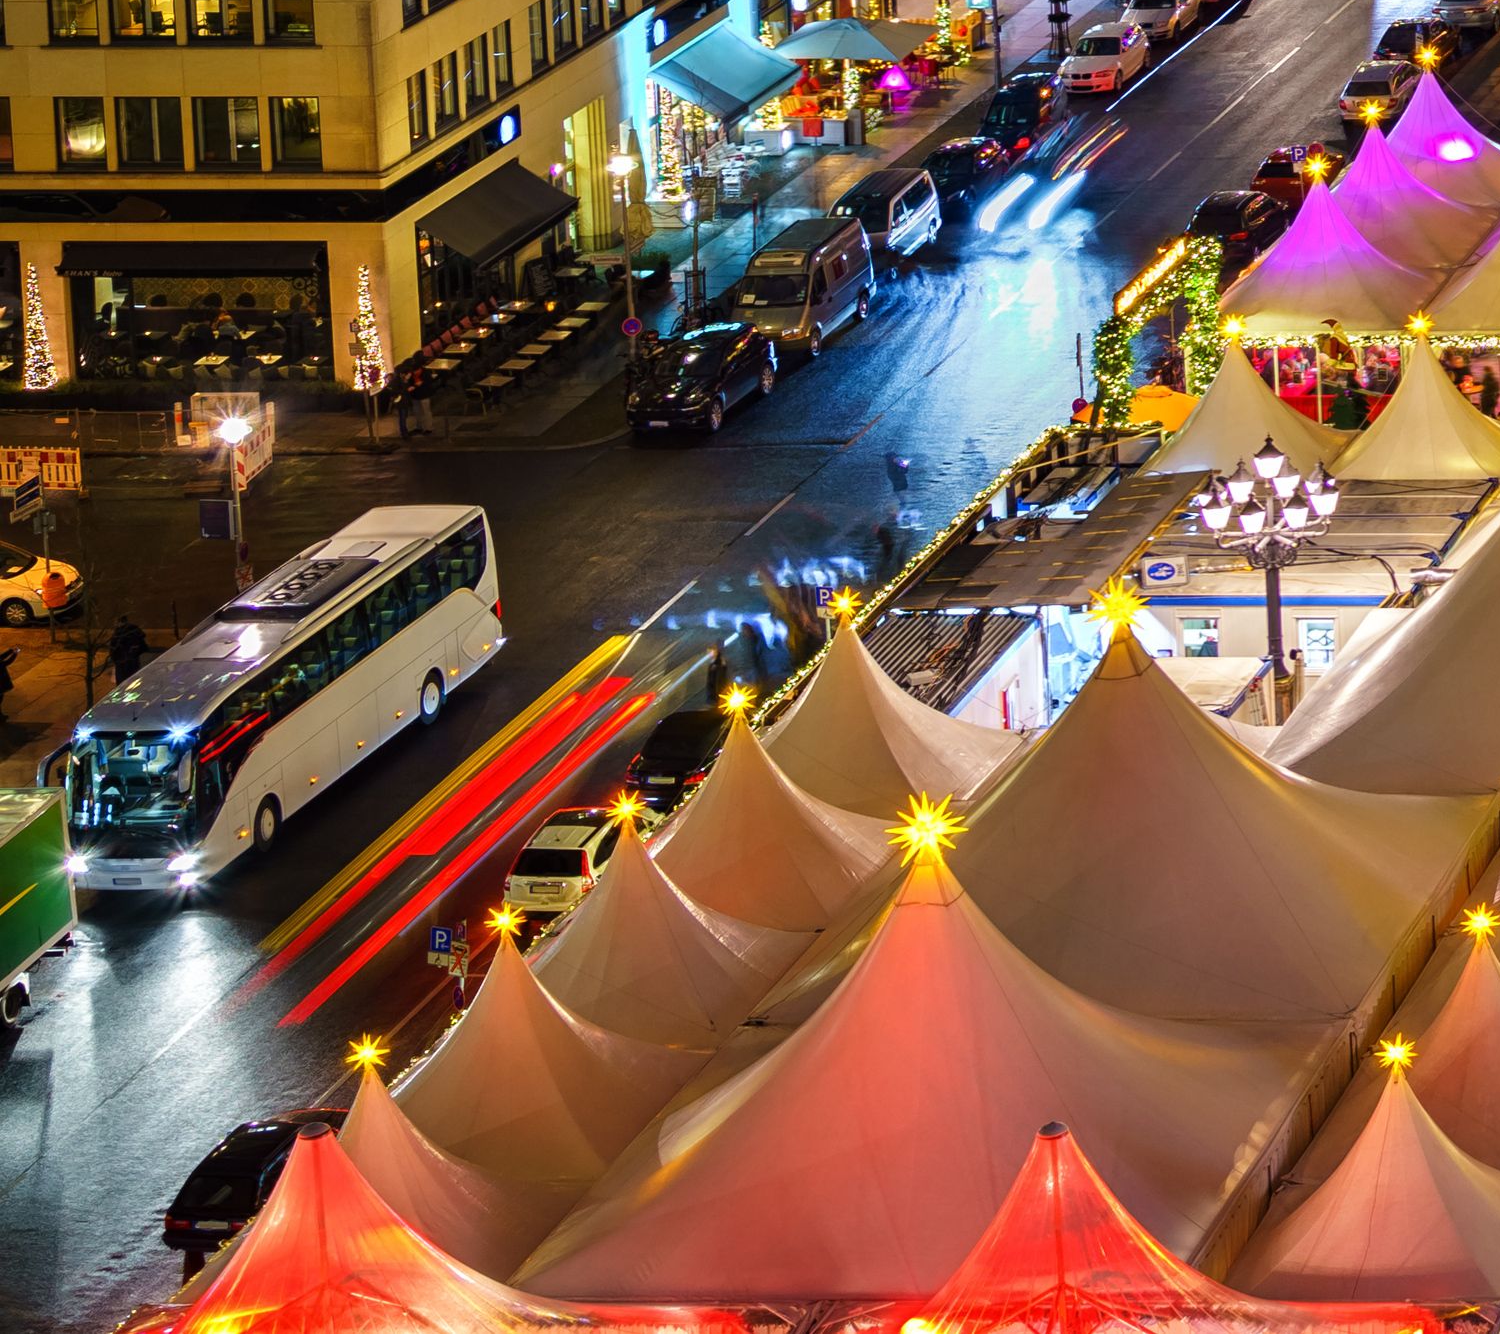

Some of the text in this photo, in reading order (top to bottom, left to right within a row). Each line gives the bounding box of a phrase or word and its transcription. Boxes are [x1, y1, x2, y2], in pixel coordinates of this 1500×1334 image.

[1294, 148, 1304, 161] P
[819, 588, 830, 605] P
[435, 930, 448, 949] P
